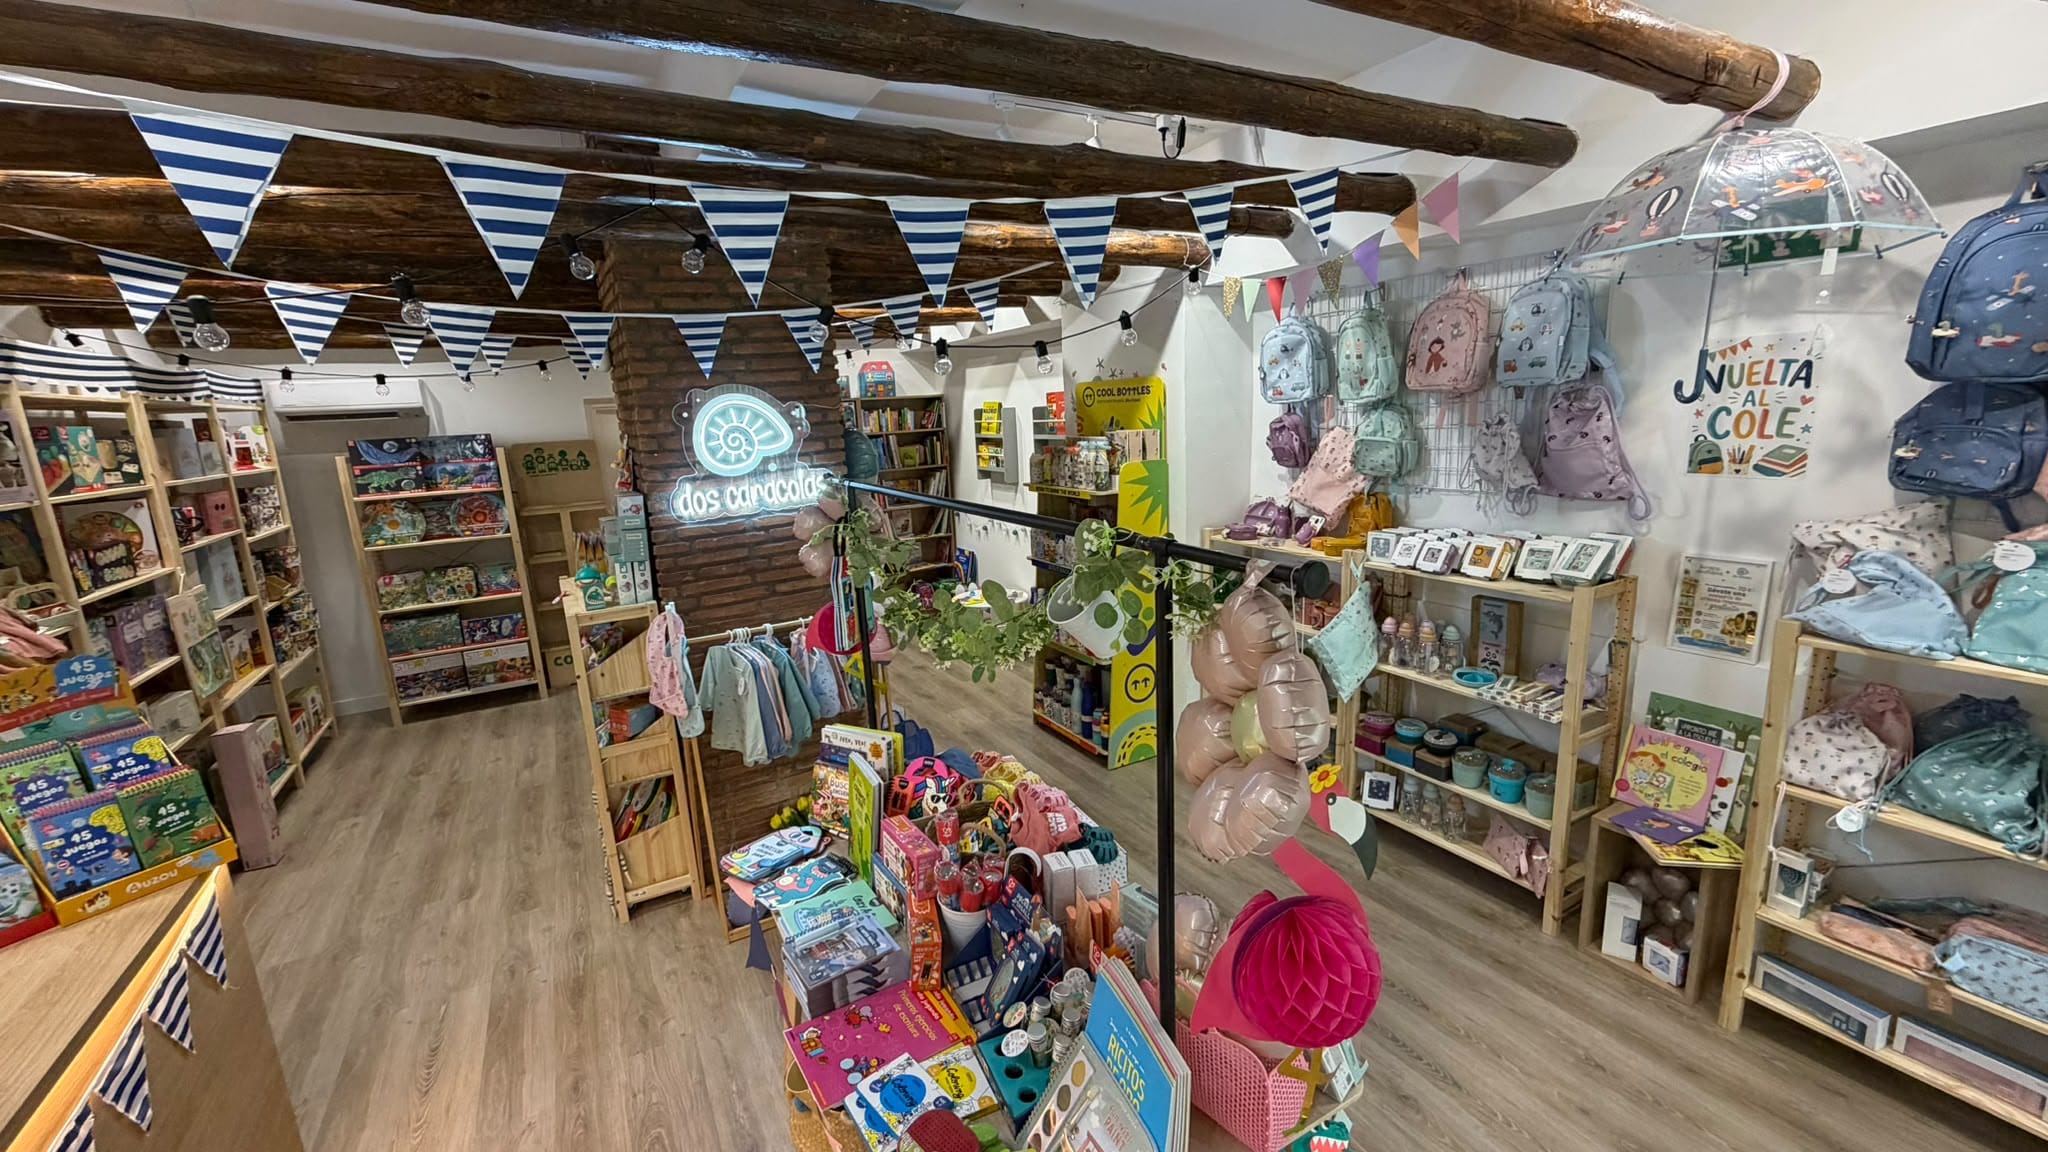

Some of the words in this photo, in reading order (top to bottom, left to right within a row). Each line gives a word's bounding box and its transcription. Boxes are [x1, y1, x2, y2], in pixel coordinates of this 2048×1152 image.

[1704, 358, 1814, 394] VUELTA
[1096, 388, 1115, 397] COOL
[1117, 385, 1151, 397] BOTTLES
[1741, 388, 1770, 407] AL
[1706, 405, 1801, 440] COLE
[678, 482, 721, 515] dos
[70, 659, 96, 674] 45
[117, 757, 136, 768] 45
[1671, 755, 1708, 773] colegio
[27, 779, 48, 793] 45
[829, 776, 850, 791] BUSC
[158, 802, 177, 816] 45
[71, 829, 92, 843] 45
[897, 989, 919, 1015] Primeros
[1107, 1033, 1146, 1102] RICITOS
